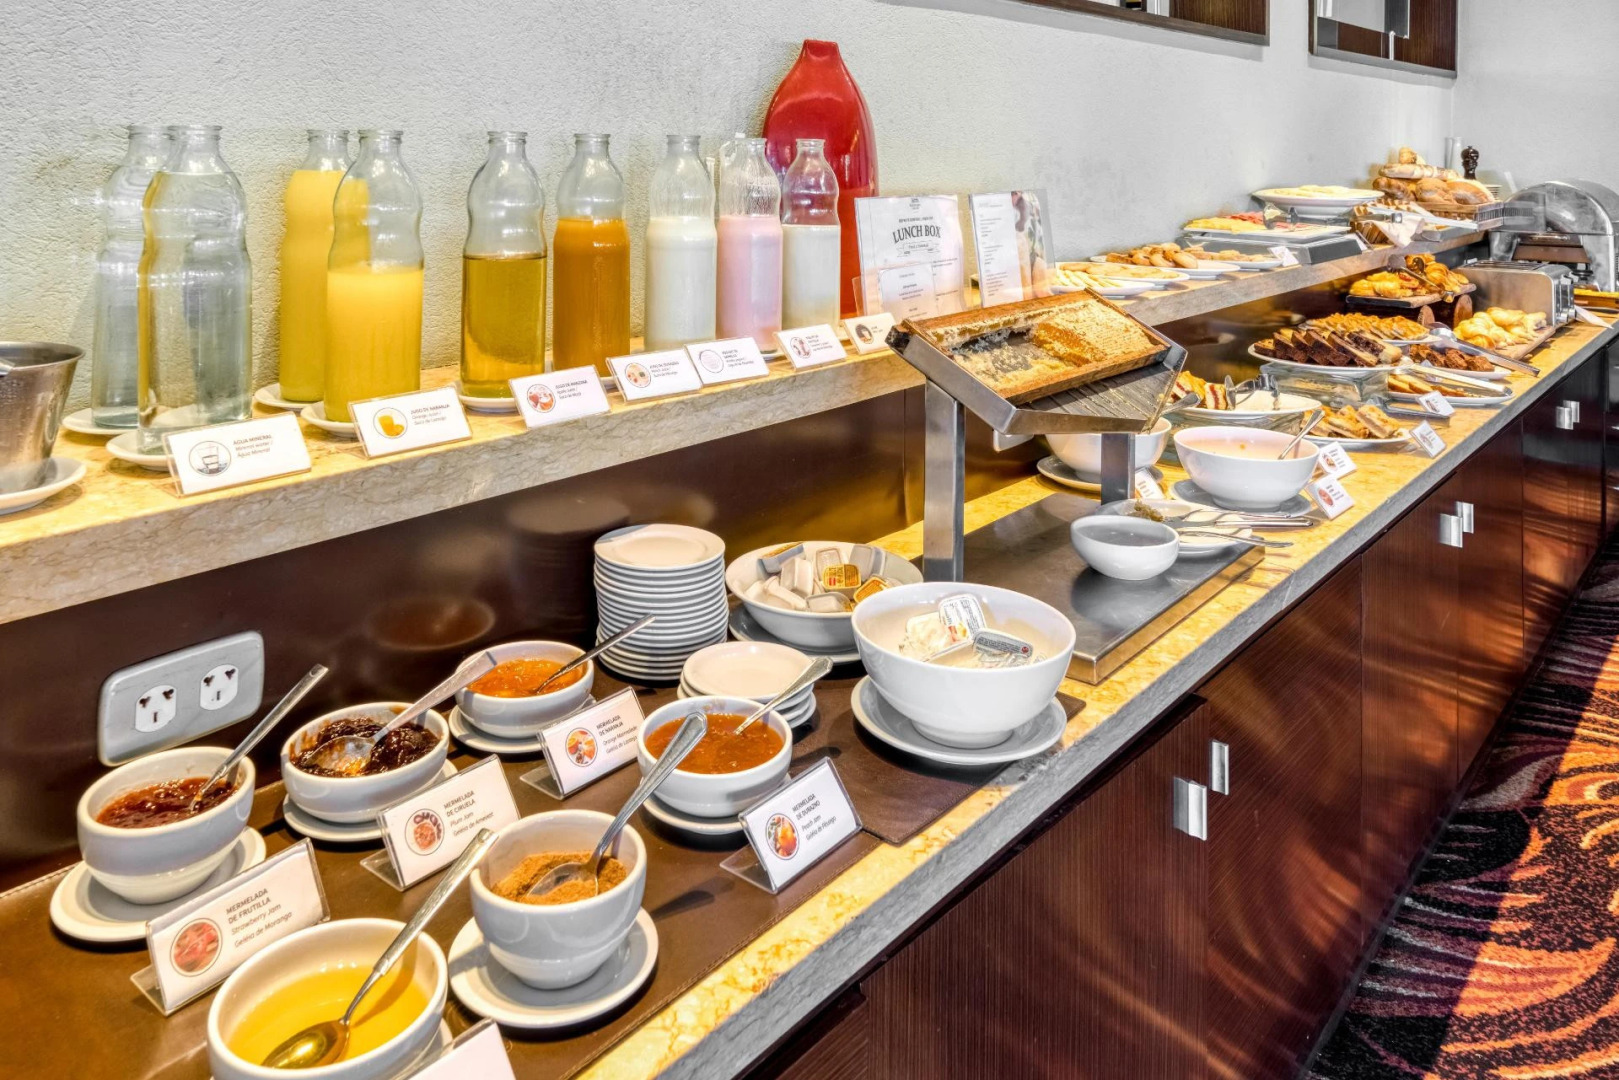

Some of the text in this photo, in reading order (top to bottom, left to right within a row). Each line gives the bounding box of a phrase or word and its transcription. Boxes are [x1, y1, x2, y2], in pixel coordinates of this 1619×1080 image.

[892, 225, 941, 244] LUNCH BOX
[596, 715, 621, 730] MERMELADA
[443, 790, 475, 809] MERMELADA
[446, 799, 476, 818] DE CIRUELA
[792, 793, 816, 812] MERMELADA
[802, 799, 821, 817] DURAZNO
[225, 888, 268, 915] MERMELADA
[228, 897, 272, 925] DE FRUTILLA
[231, 904, 282, 936] Strawberry Jam
[255, 927, 264, 936] de
